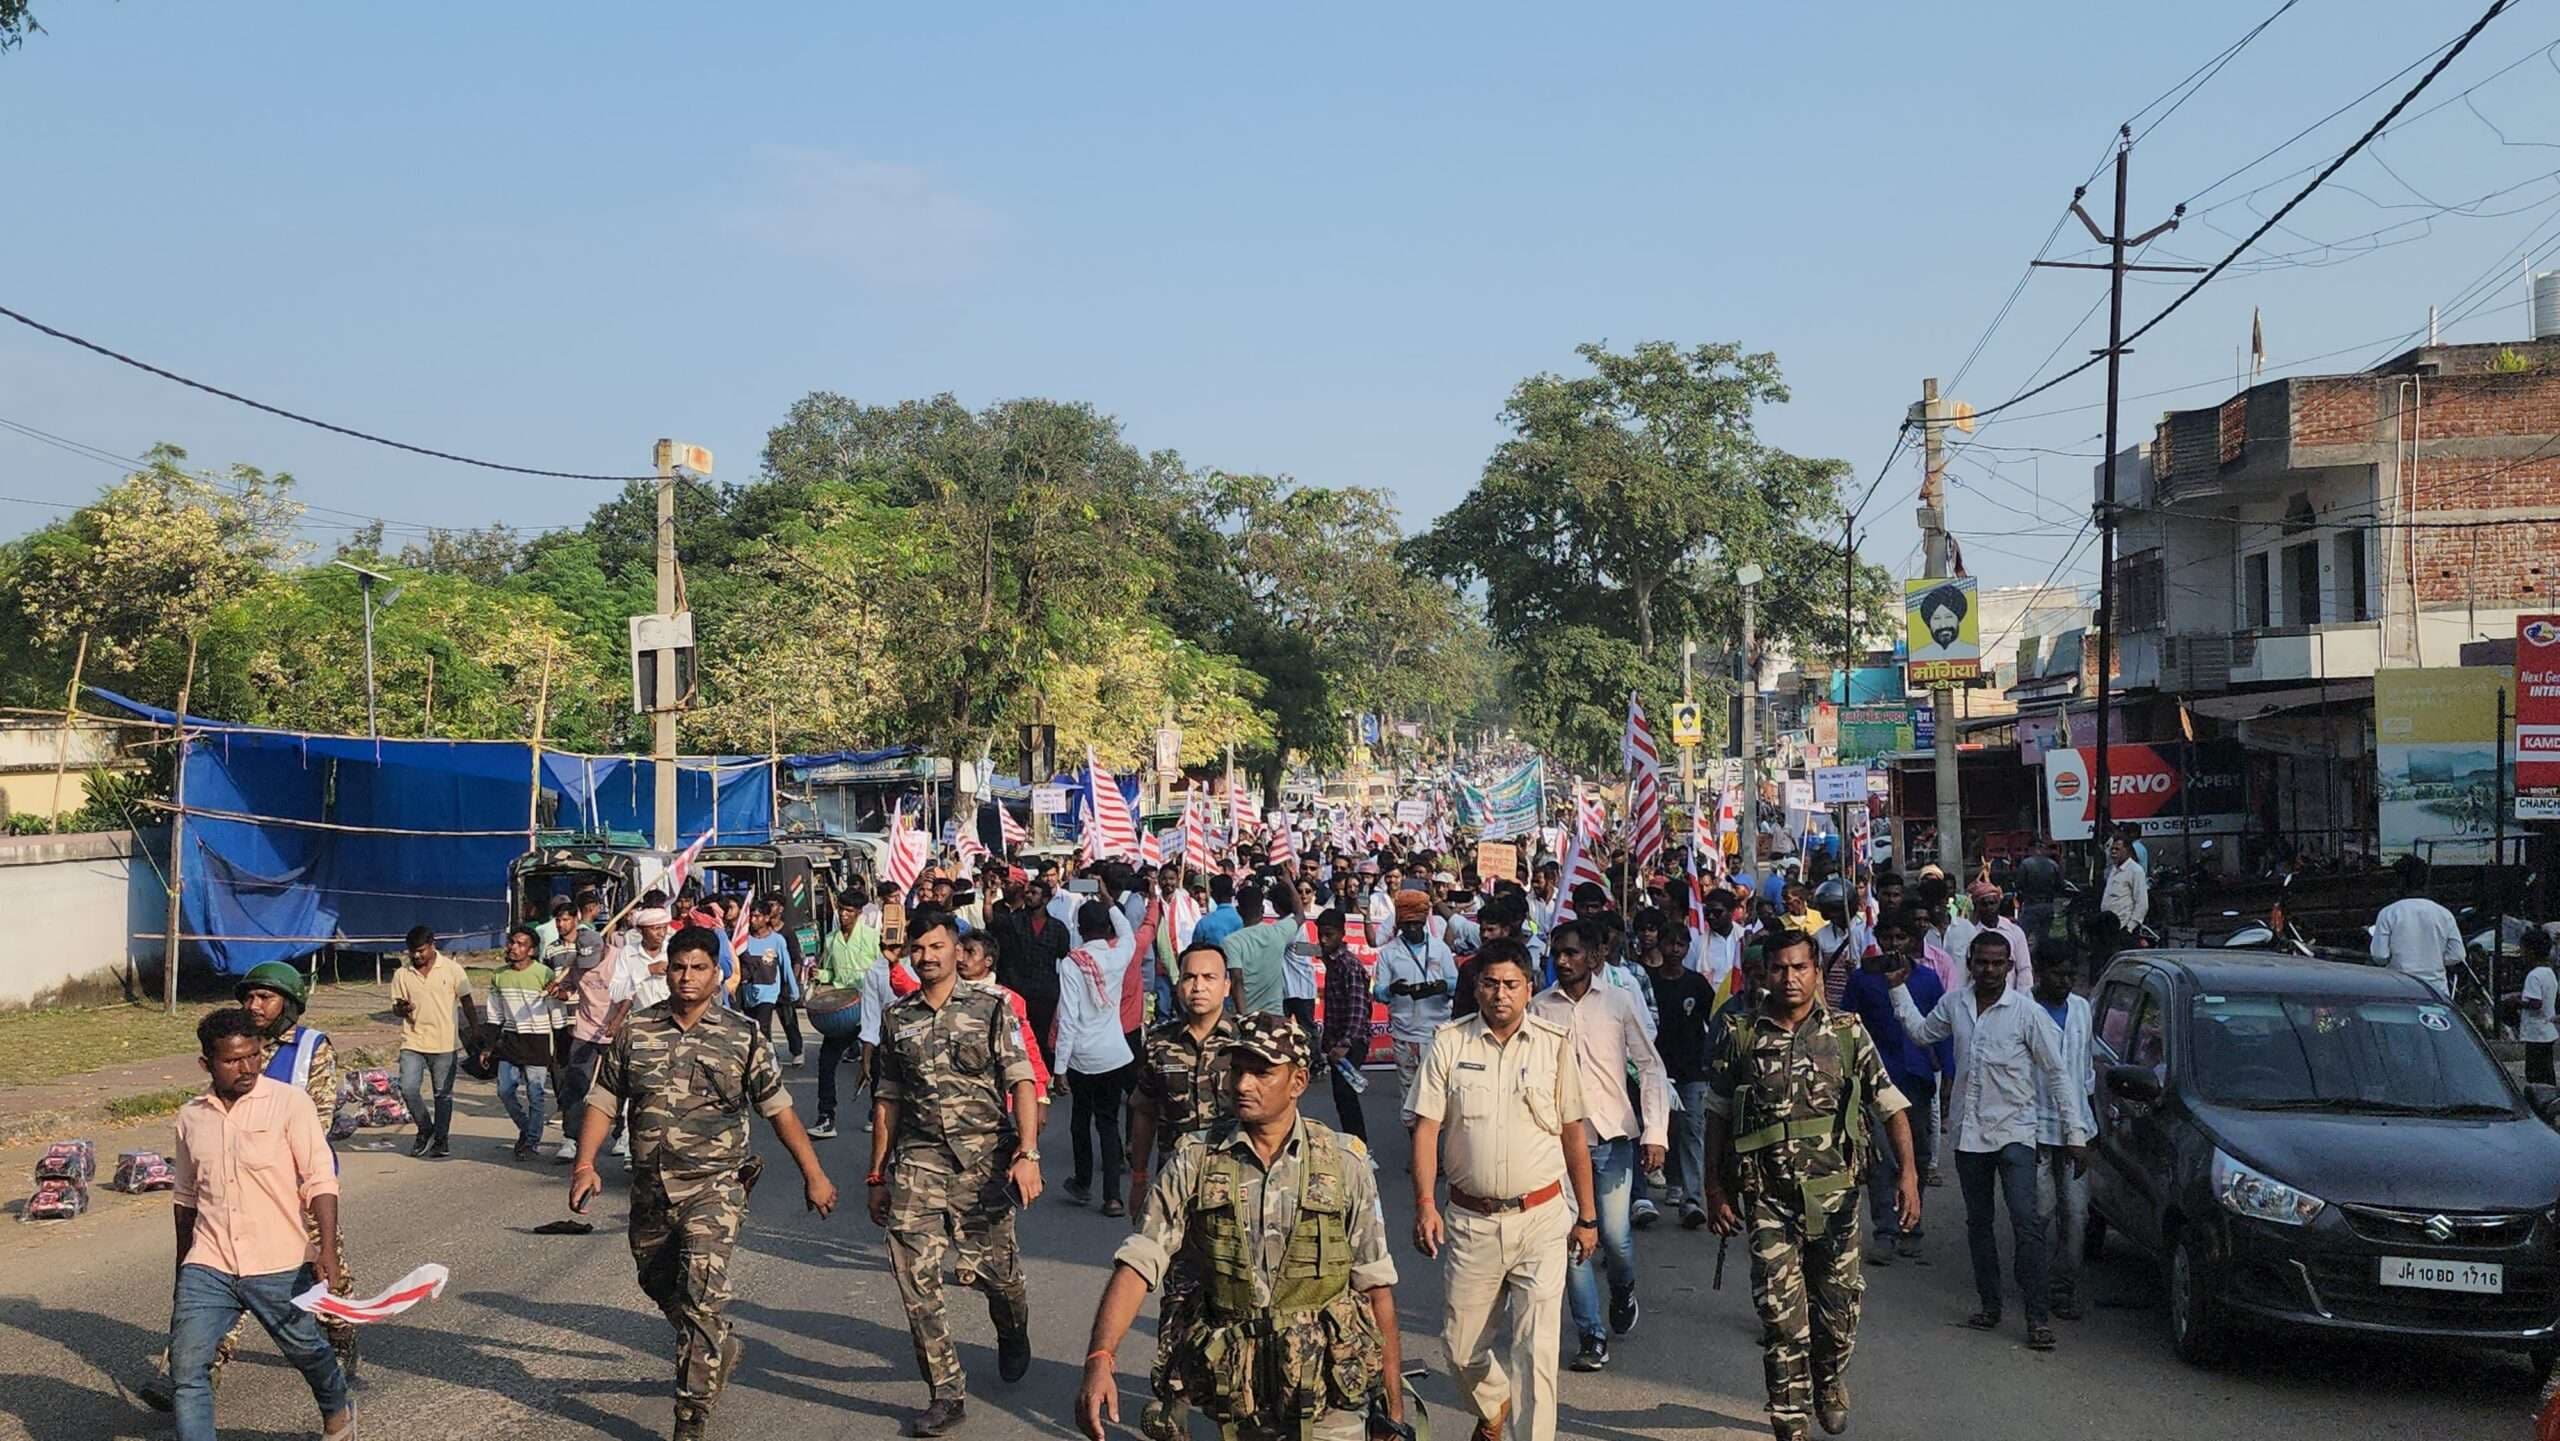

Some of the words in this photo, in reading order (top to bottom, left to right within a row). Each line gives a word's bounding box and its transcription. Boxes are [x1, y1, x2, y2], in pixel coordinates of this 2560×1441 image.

[2520, 671, 2543, 684] Next
[2091, 773, 2171, 796] ERVO
[2398, 1265, 2415, 1280] JH
[2419, 1268, 2434, 1281] 10
[2462, 1270, 2498, 1286] 1716
